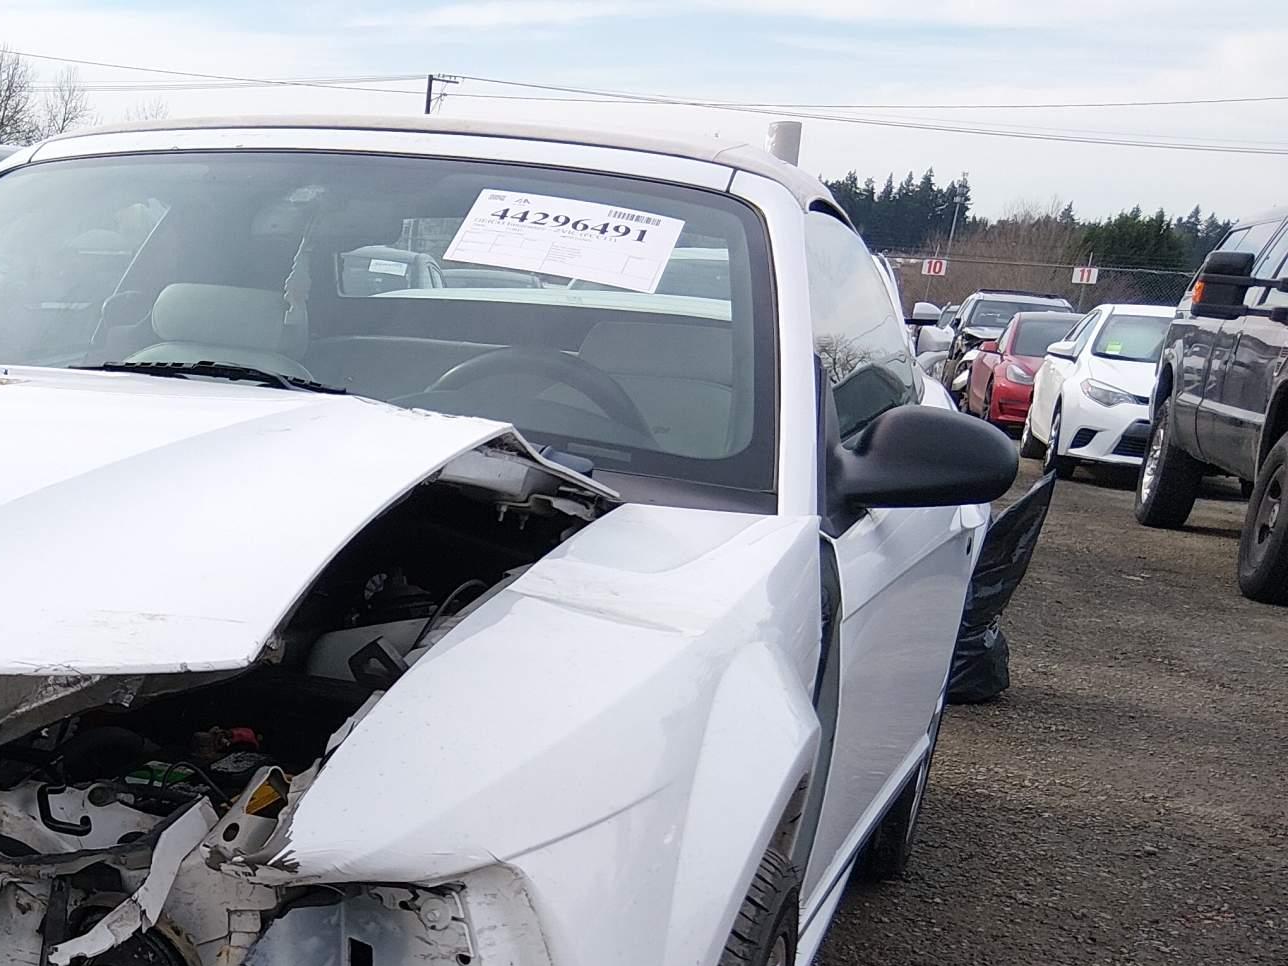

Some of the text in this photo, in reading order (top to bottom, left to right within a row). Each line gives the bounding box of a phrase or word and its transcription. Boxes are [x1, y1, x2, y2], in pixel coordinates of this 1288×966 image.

[490, 207, 648, 243] 44296491
[926, 259, 943, 275] 10
[1079, 268, 1092, 283] 11
